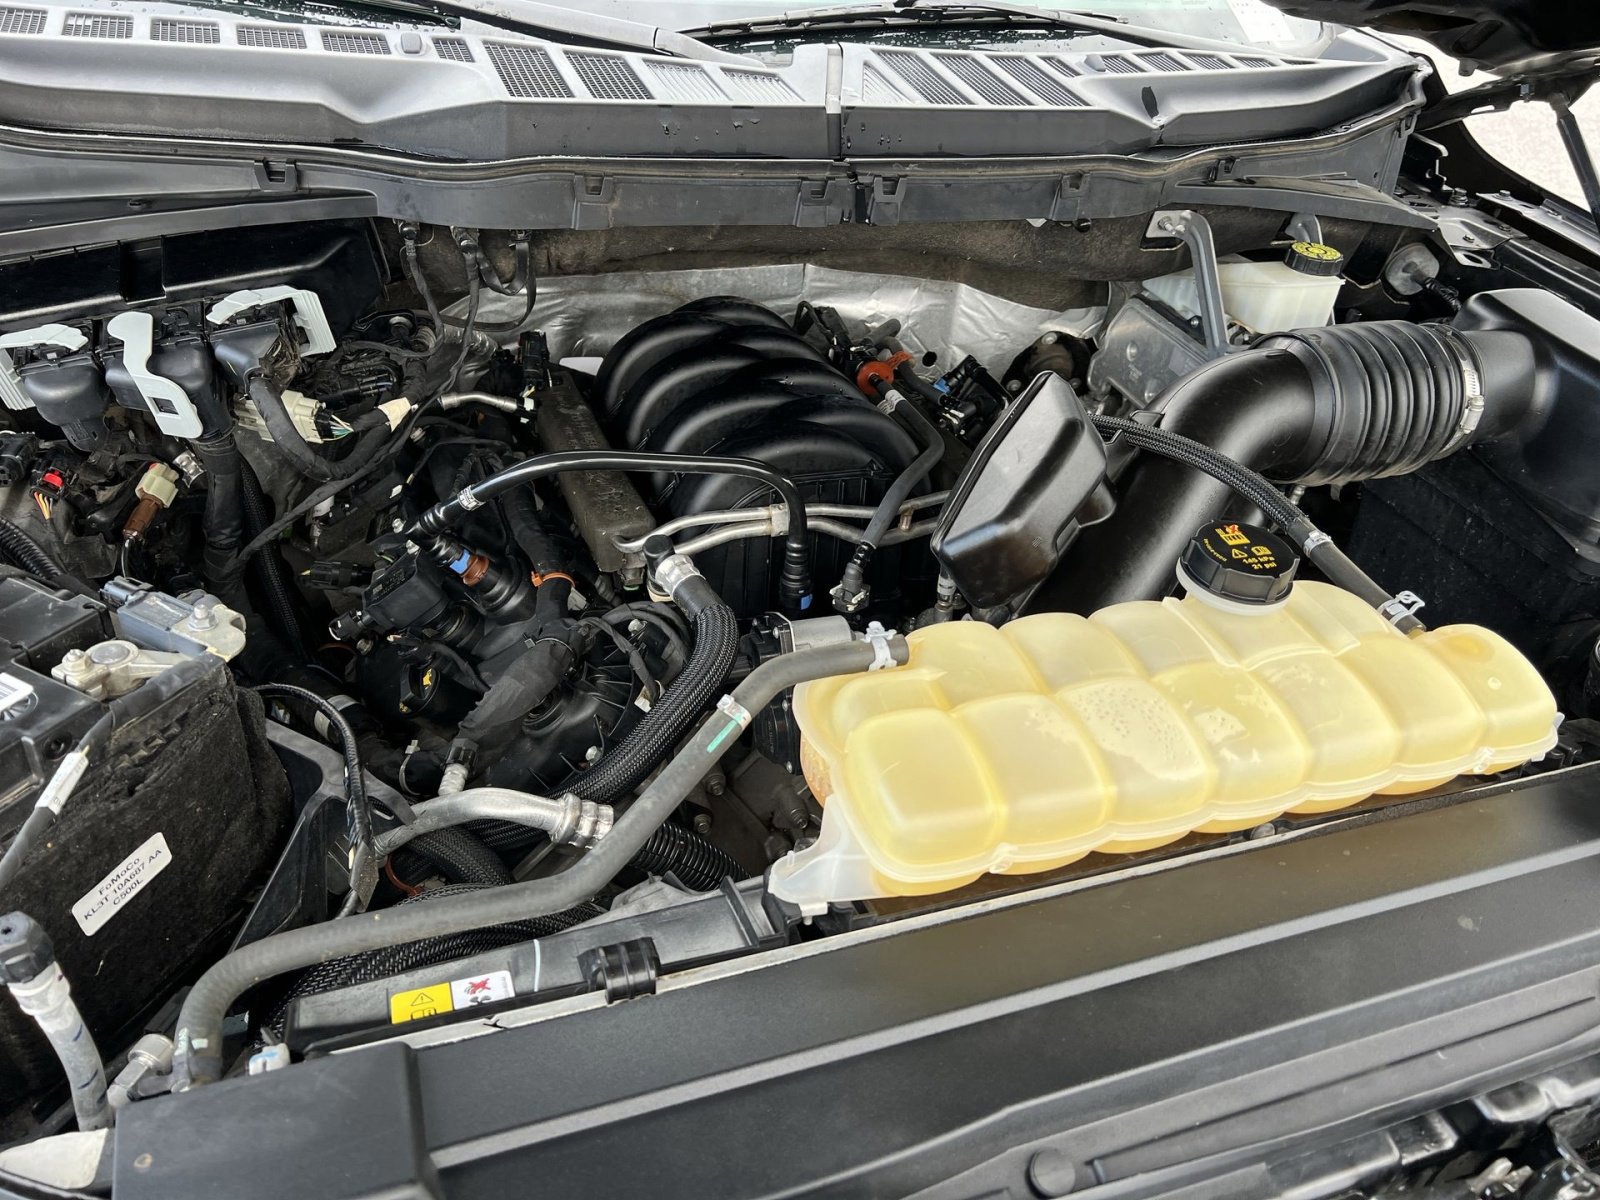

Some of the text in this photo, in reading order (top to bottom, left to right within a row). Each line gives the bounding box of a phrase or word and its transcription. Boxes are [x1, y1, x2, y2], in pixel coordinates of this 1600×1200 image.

[84, 849, 162, 920] KL3T 10A687 AA
[98, 858, 140, 895] FoMoCo
[113, 879, 144, 905] C500L
